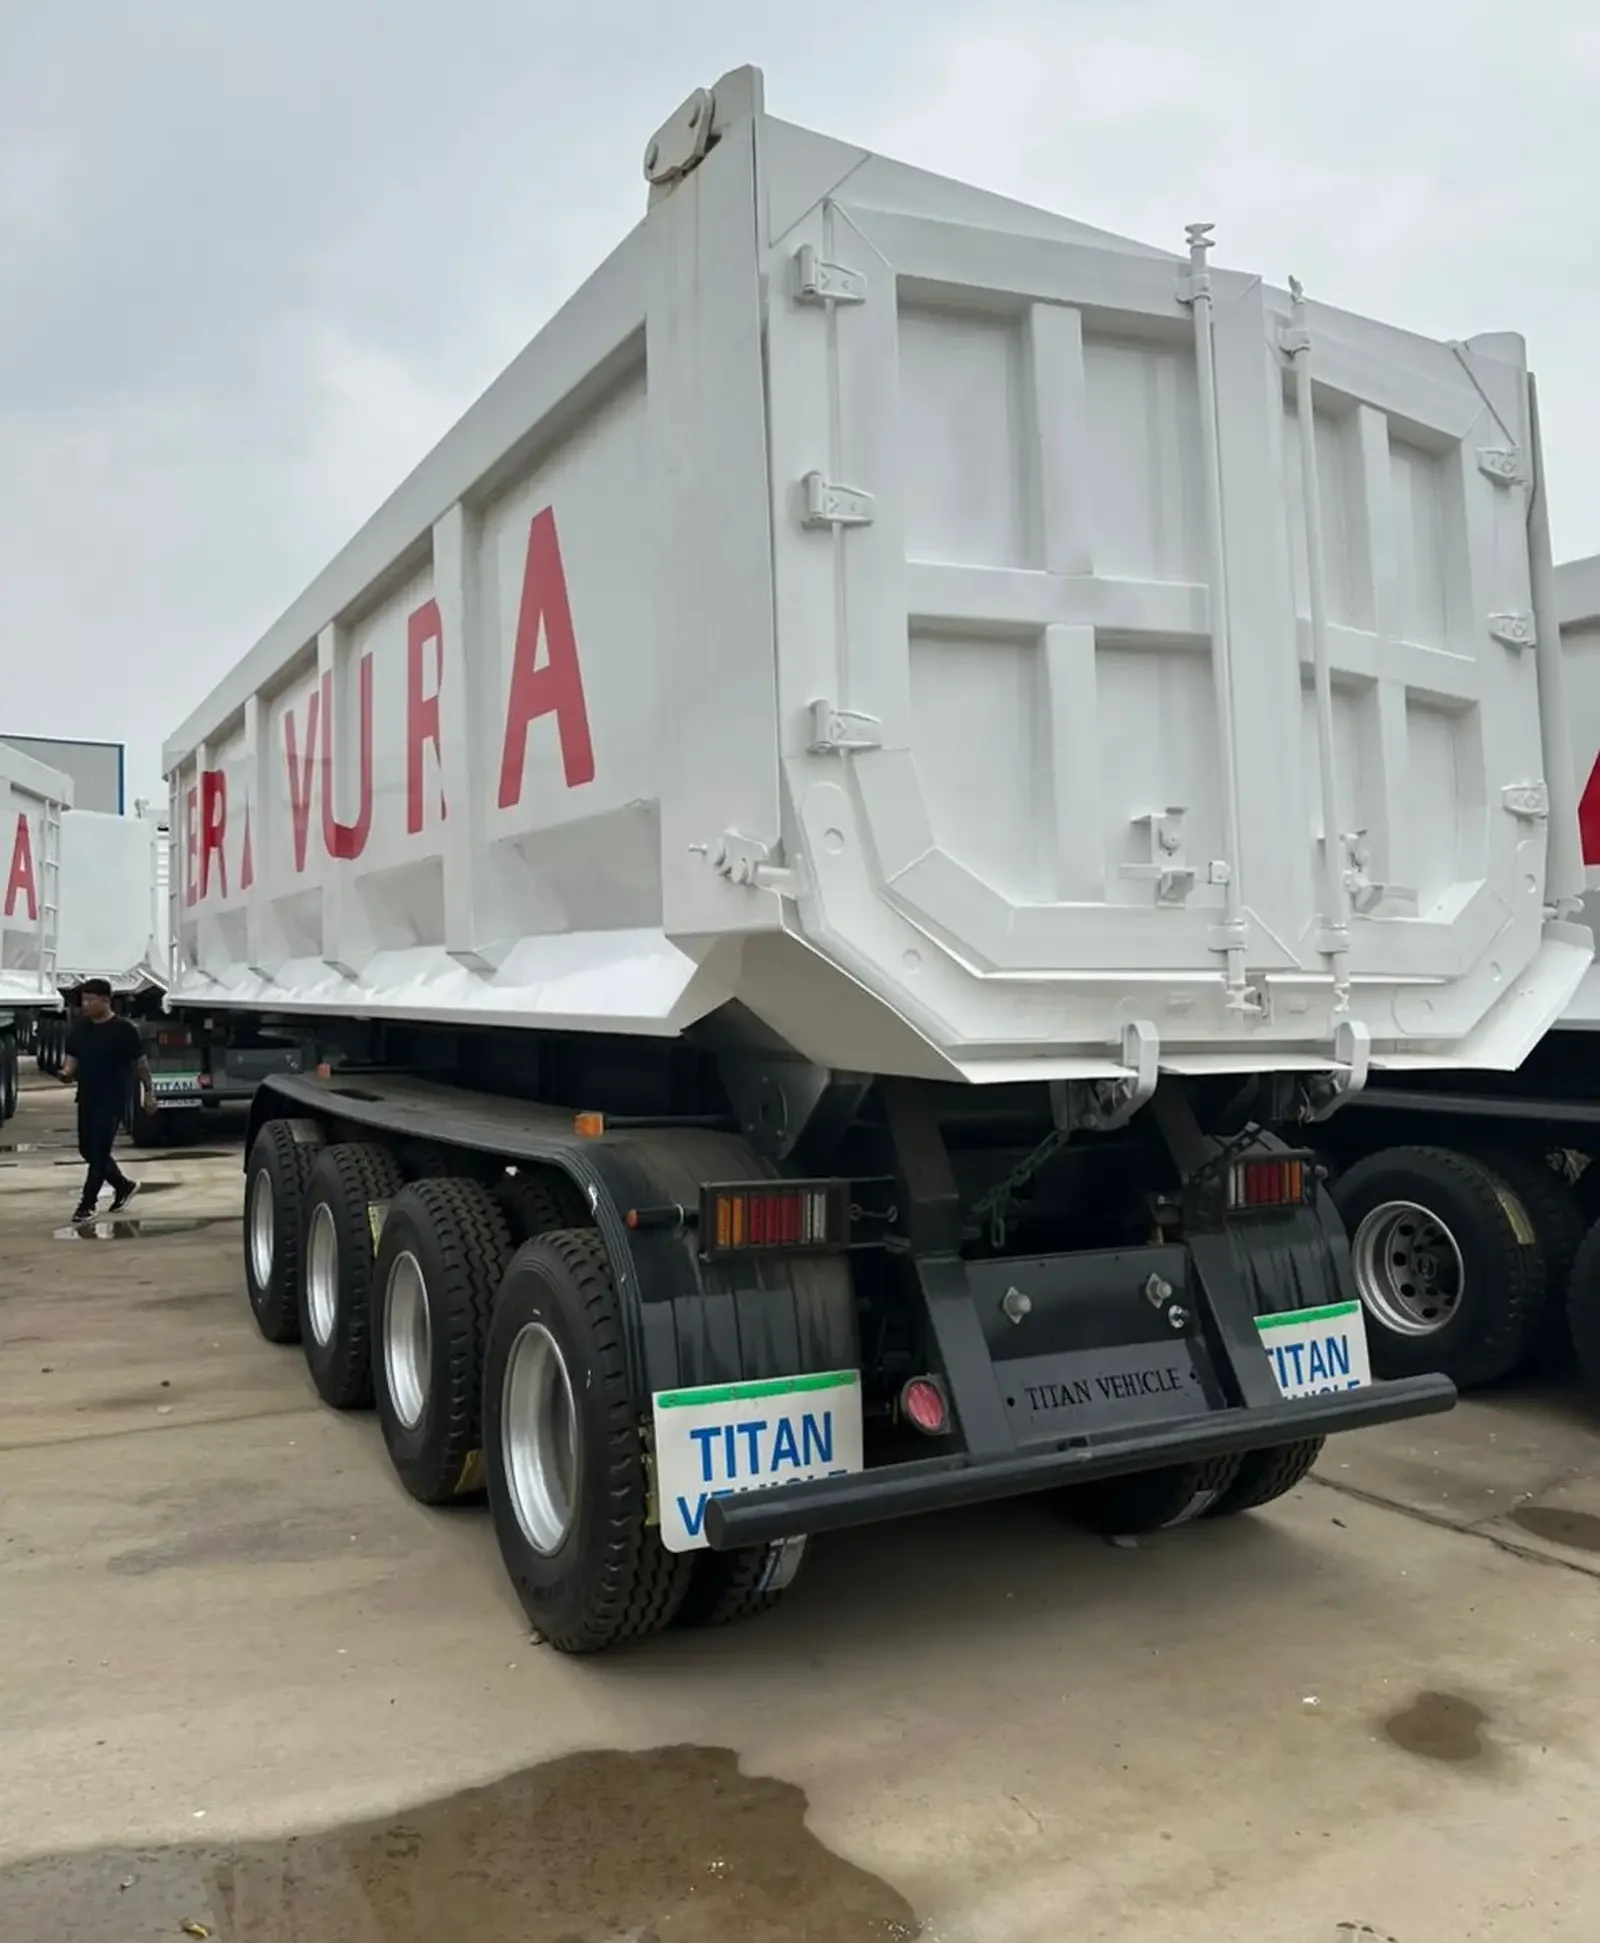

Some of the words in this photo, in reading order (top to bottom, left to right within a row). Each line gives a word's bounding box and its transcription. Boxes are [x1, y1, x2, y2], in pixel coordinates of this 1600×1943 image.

[1025, 1379, 1092, 1410] TITAN
[1096, 1367, 1183, 1400] VEHICLE
[690, 1411, 833, 1482] TITAN
